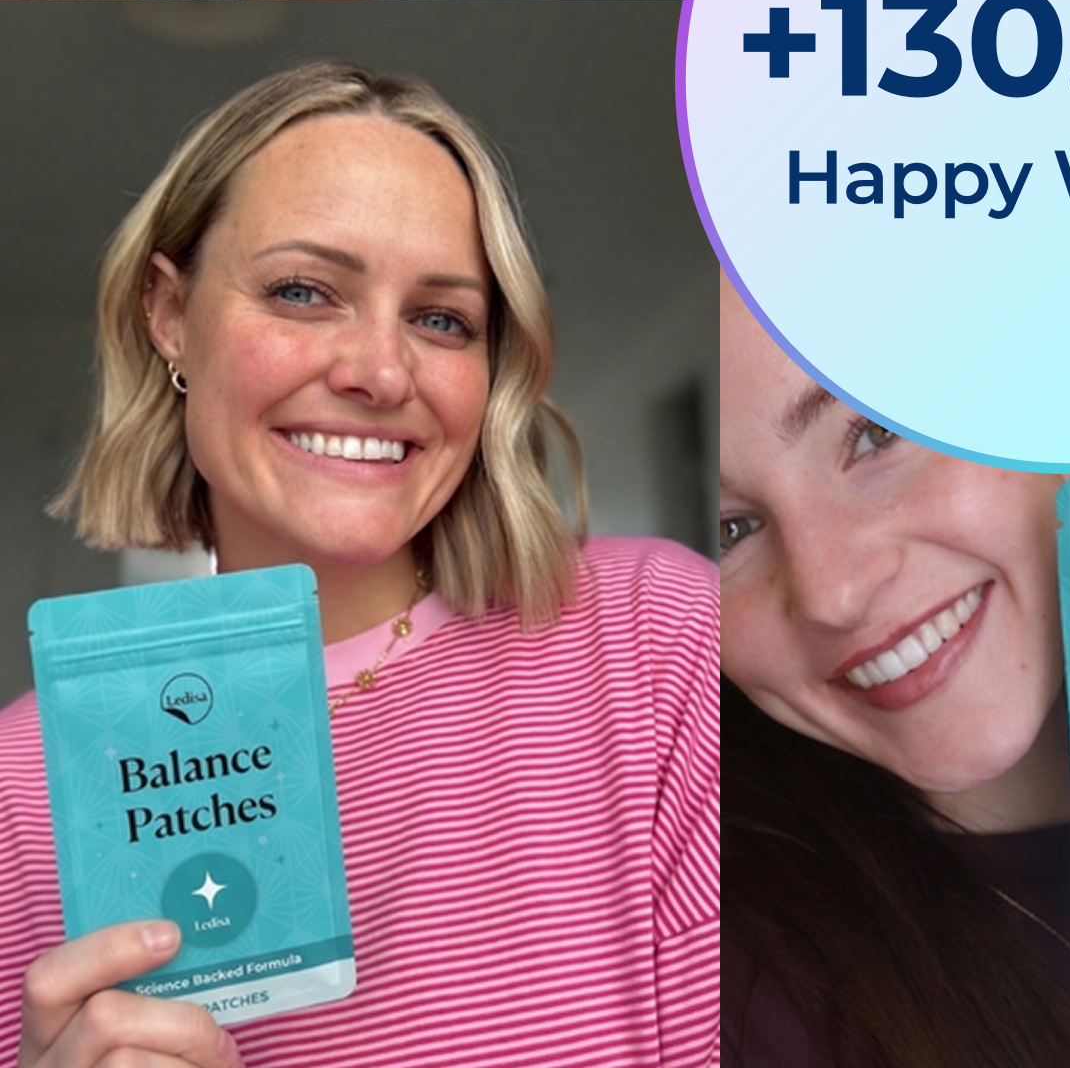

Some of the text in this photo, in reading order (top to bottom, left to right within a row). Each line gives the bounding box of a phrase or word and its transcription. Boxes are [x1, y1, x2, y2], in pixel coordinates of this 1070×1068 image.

[165, 690, 209, 708] Ledisa
[118, 744, 273, 794] Balance
[125, 791, 278, 843] Patches
[135, 953, 303, 997] Science Backed Formula
